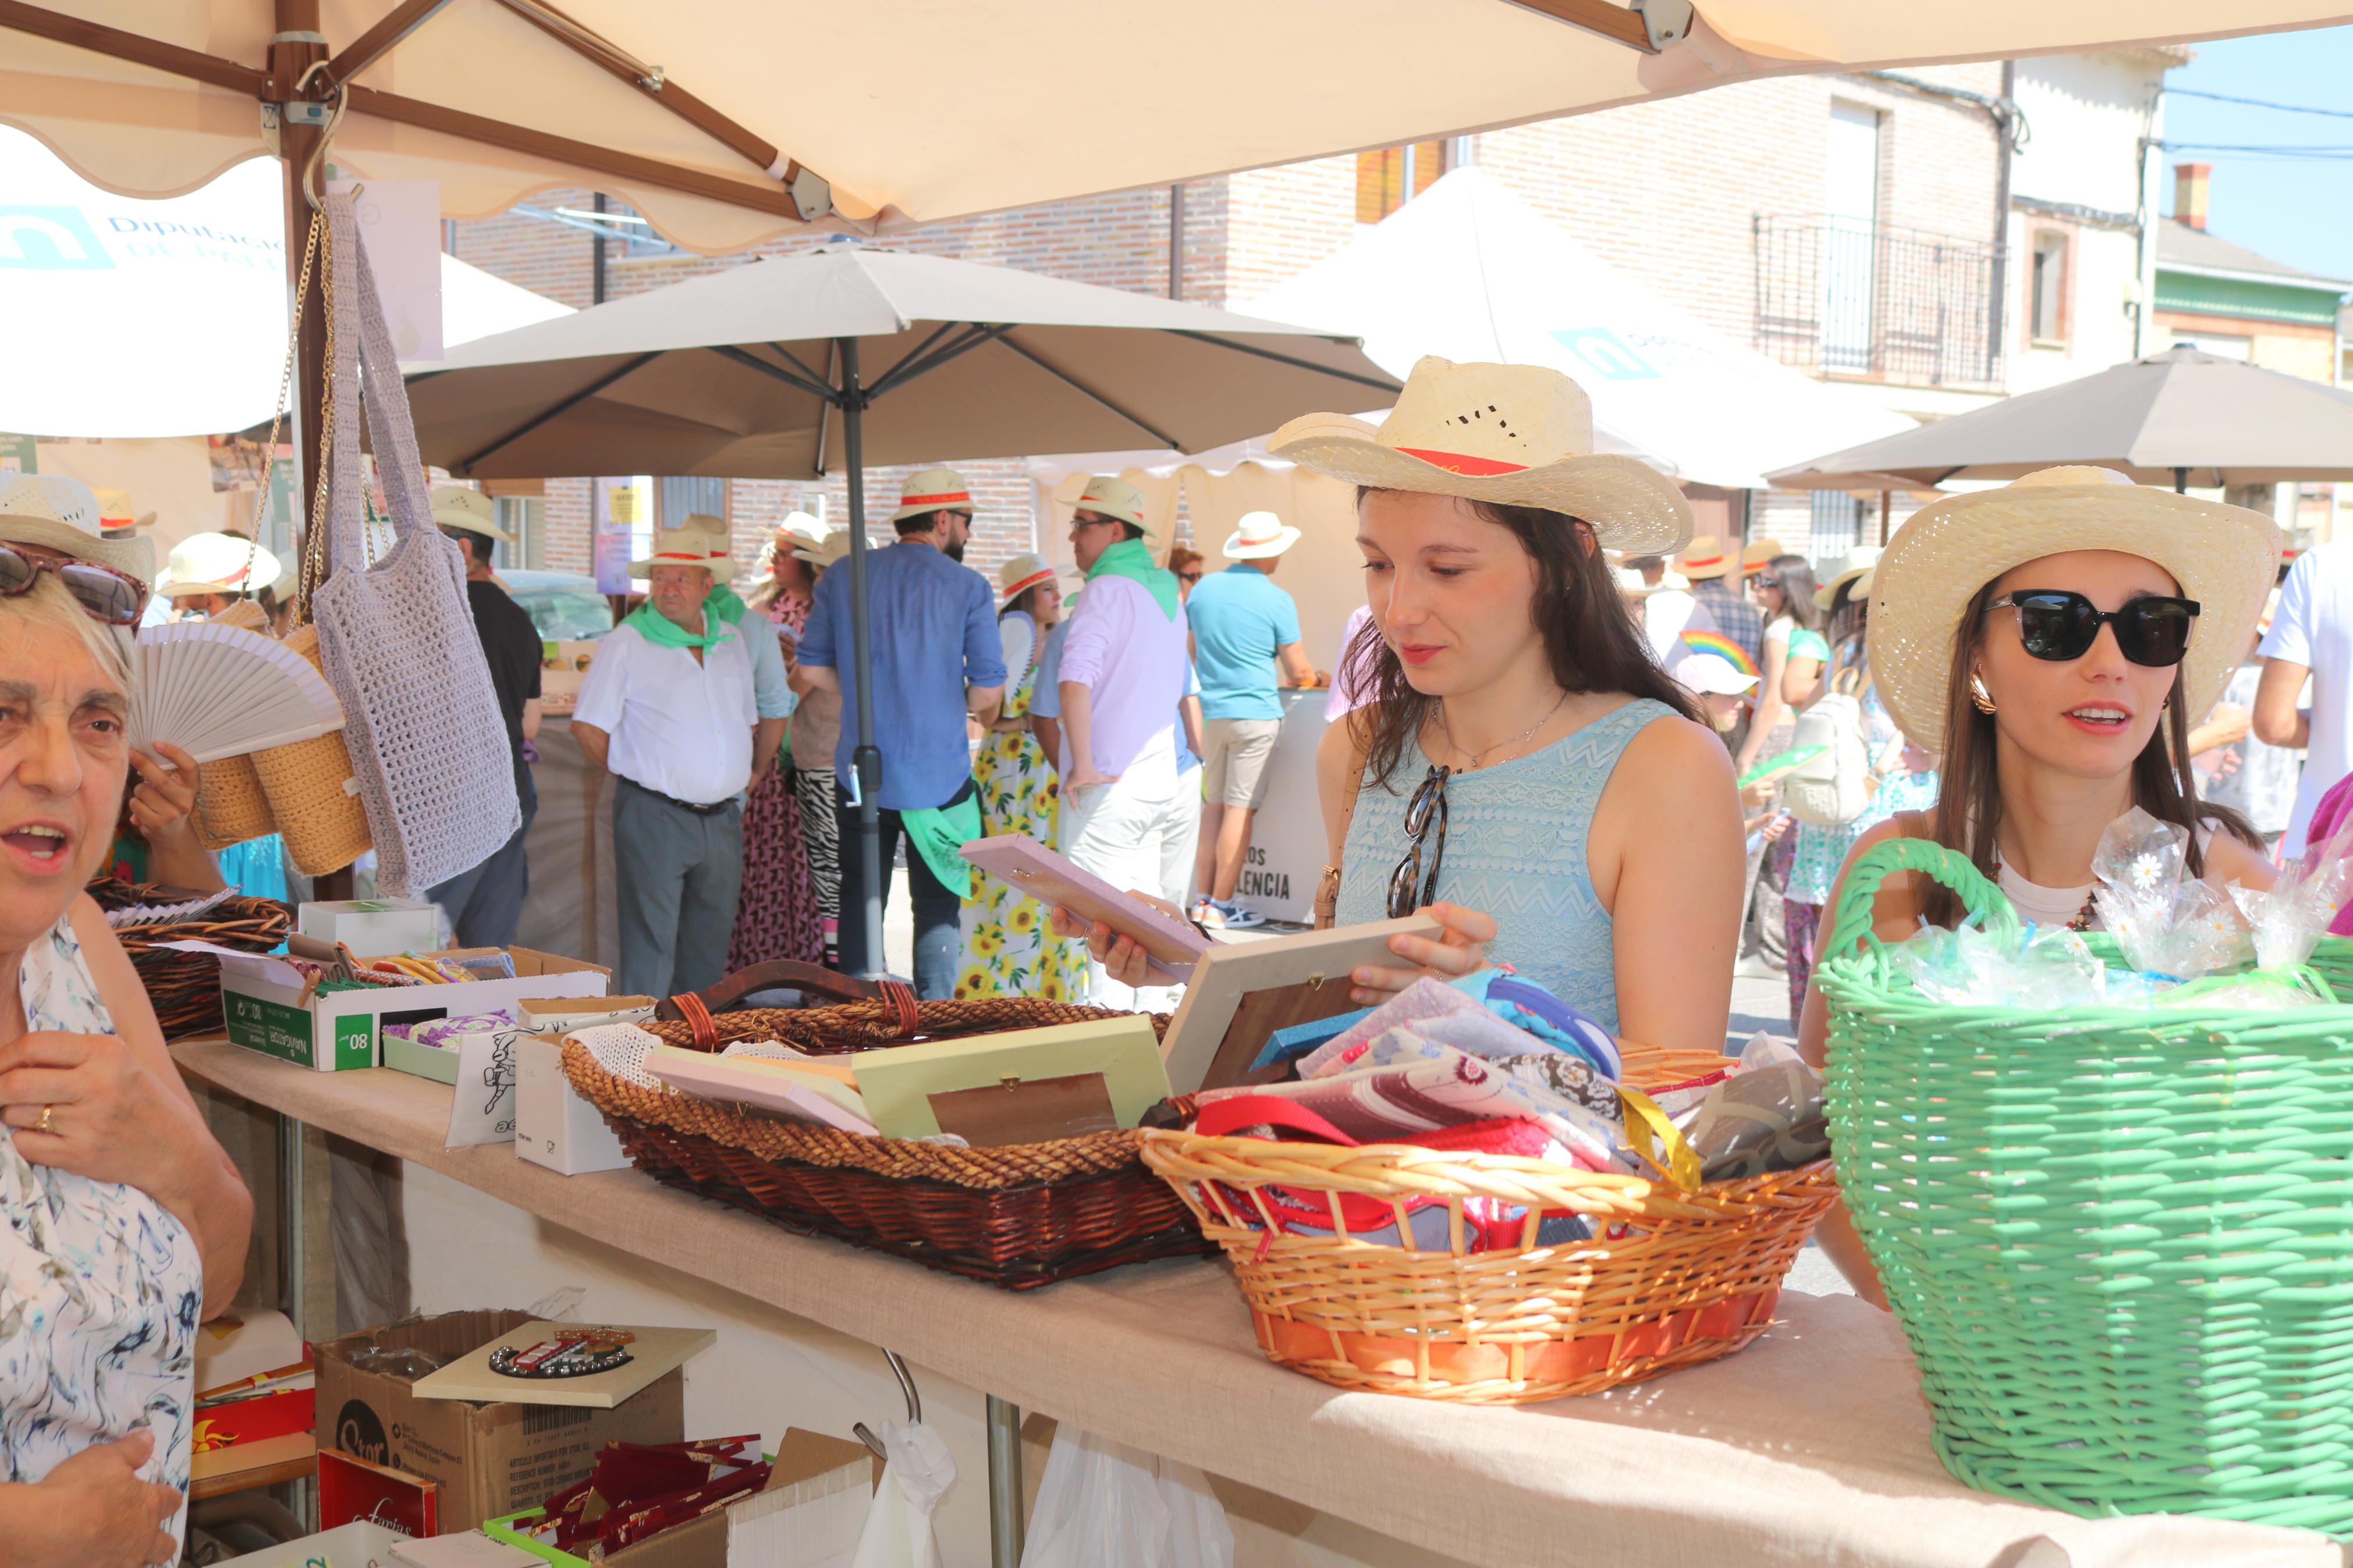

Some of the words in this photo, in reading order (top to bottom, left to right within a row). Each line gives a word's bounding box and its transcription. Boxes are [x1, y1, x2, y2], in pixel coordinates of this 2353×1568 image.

[1244, 846, 1266, 866] OS
[252, 1004, 261, 1021] 80
[269, 1031, 307, 1054] NAVIGATOR
[350, 1033, 368, 1050] 80
[340, 1418, 385, 1463] Stor
